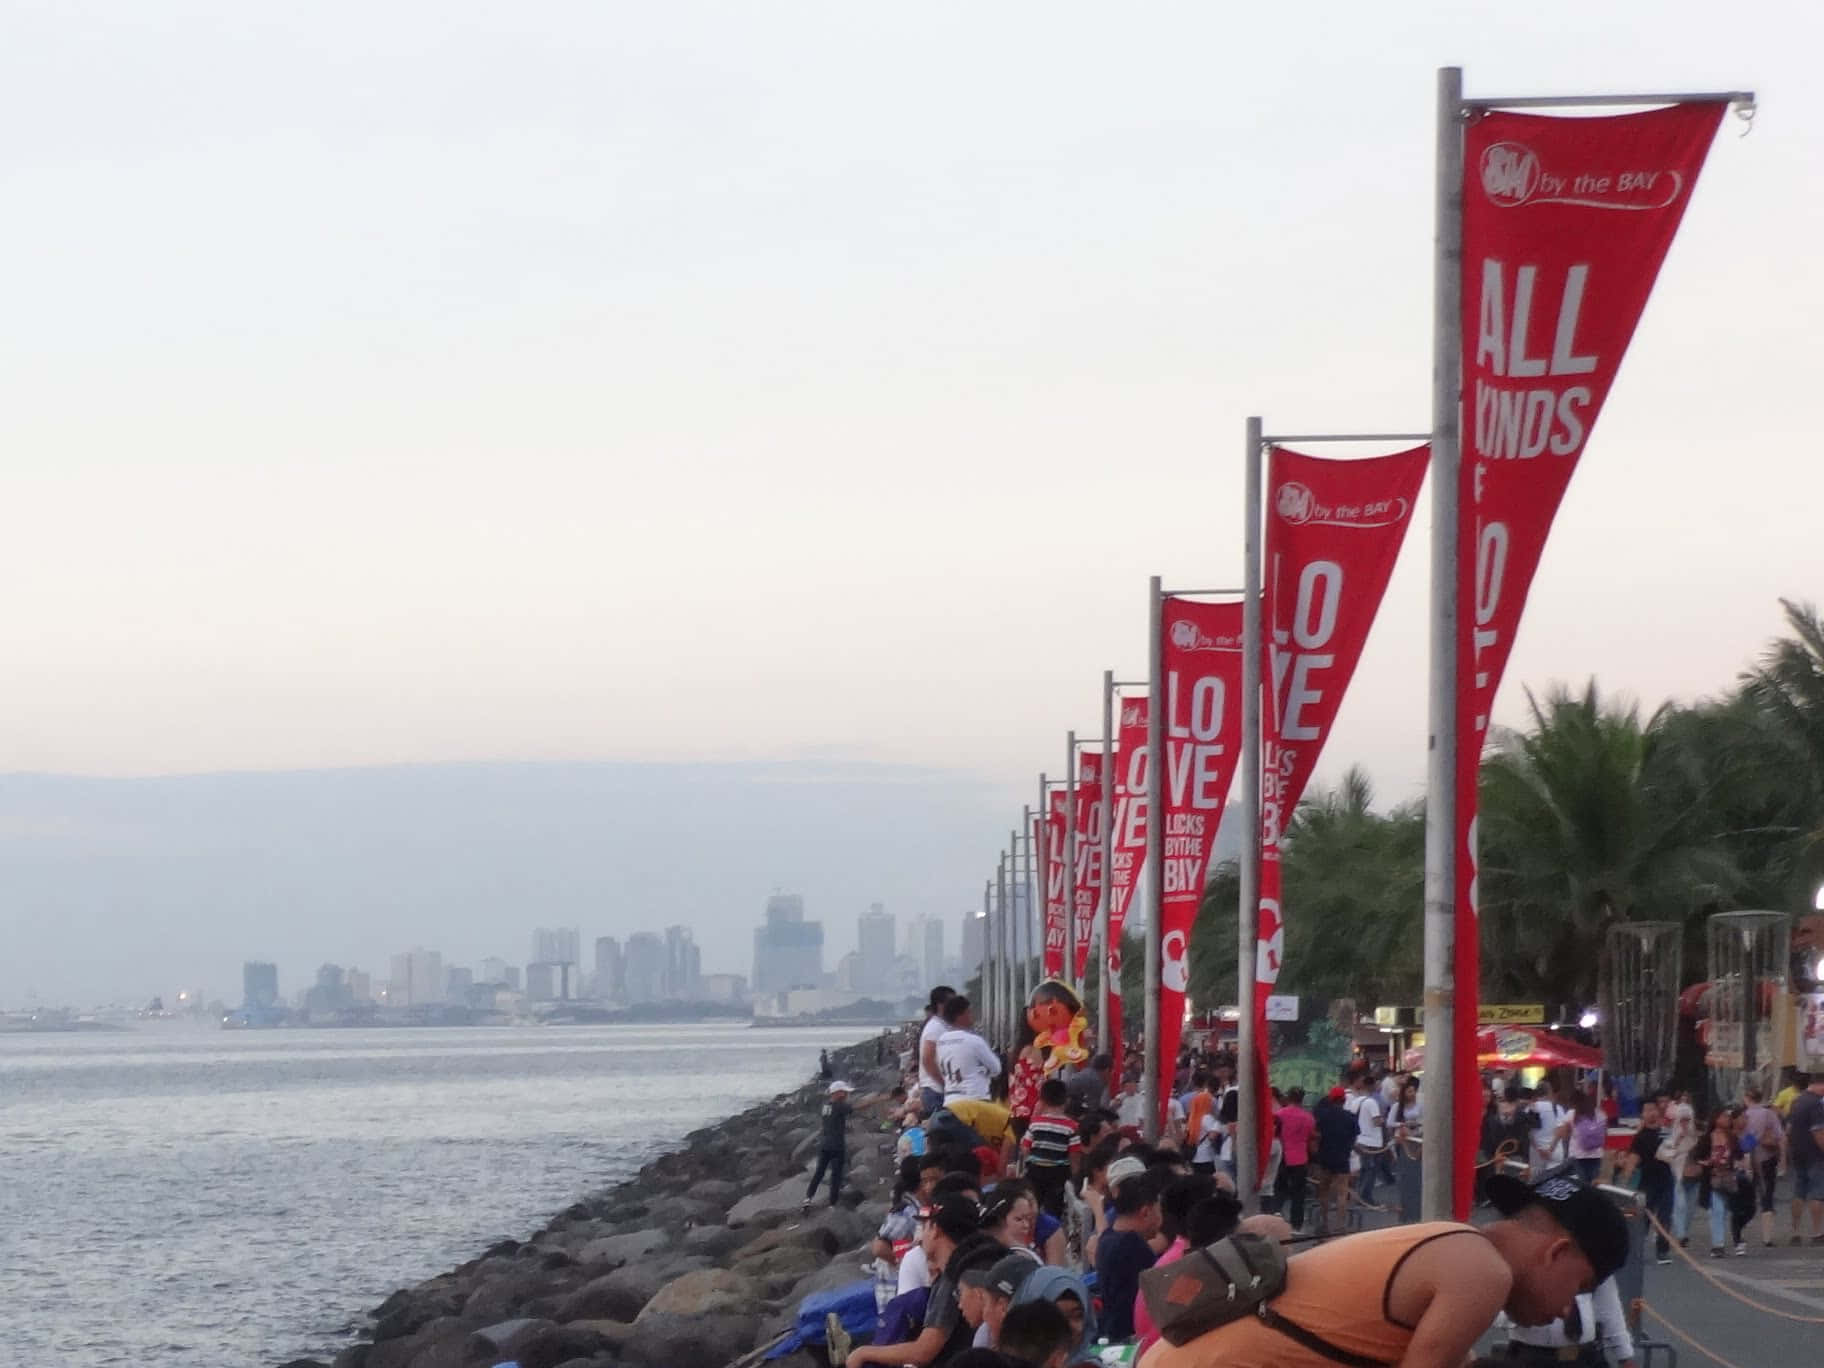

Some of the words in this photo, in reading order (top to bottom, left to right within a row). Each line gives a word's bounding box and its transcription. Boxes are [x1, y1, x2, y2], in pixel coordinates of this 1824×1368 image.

[1540, 173, 1567, 195] by
[1574, 174, 1610, 193] the
[1617, 171, 1660, 192] BAY
[1477, 258, 1599, 378] ALL
[1168, 670, 1225, 741] LO
[1166, 741, 1225, 809] VE
[1164, 858, 1202, 893] BAY
